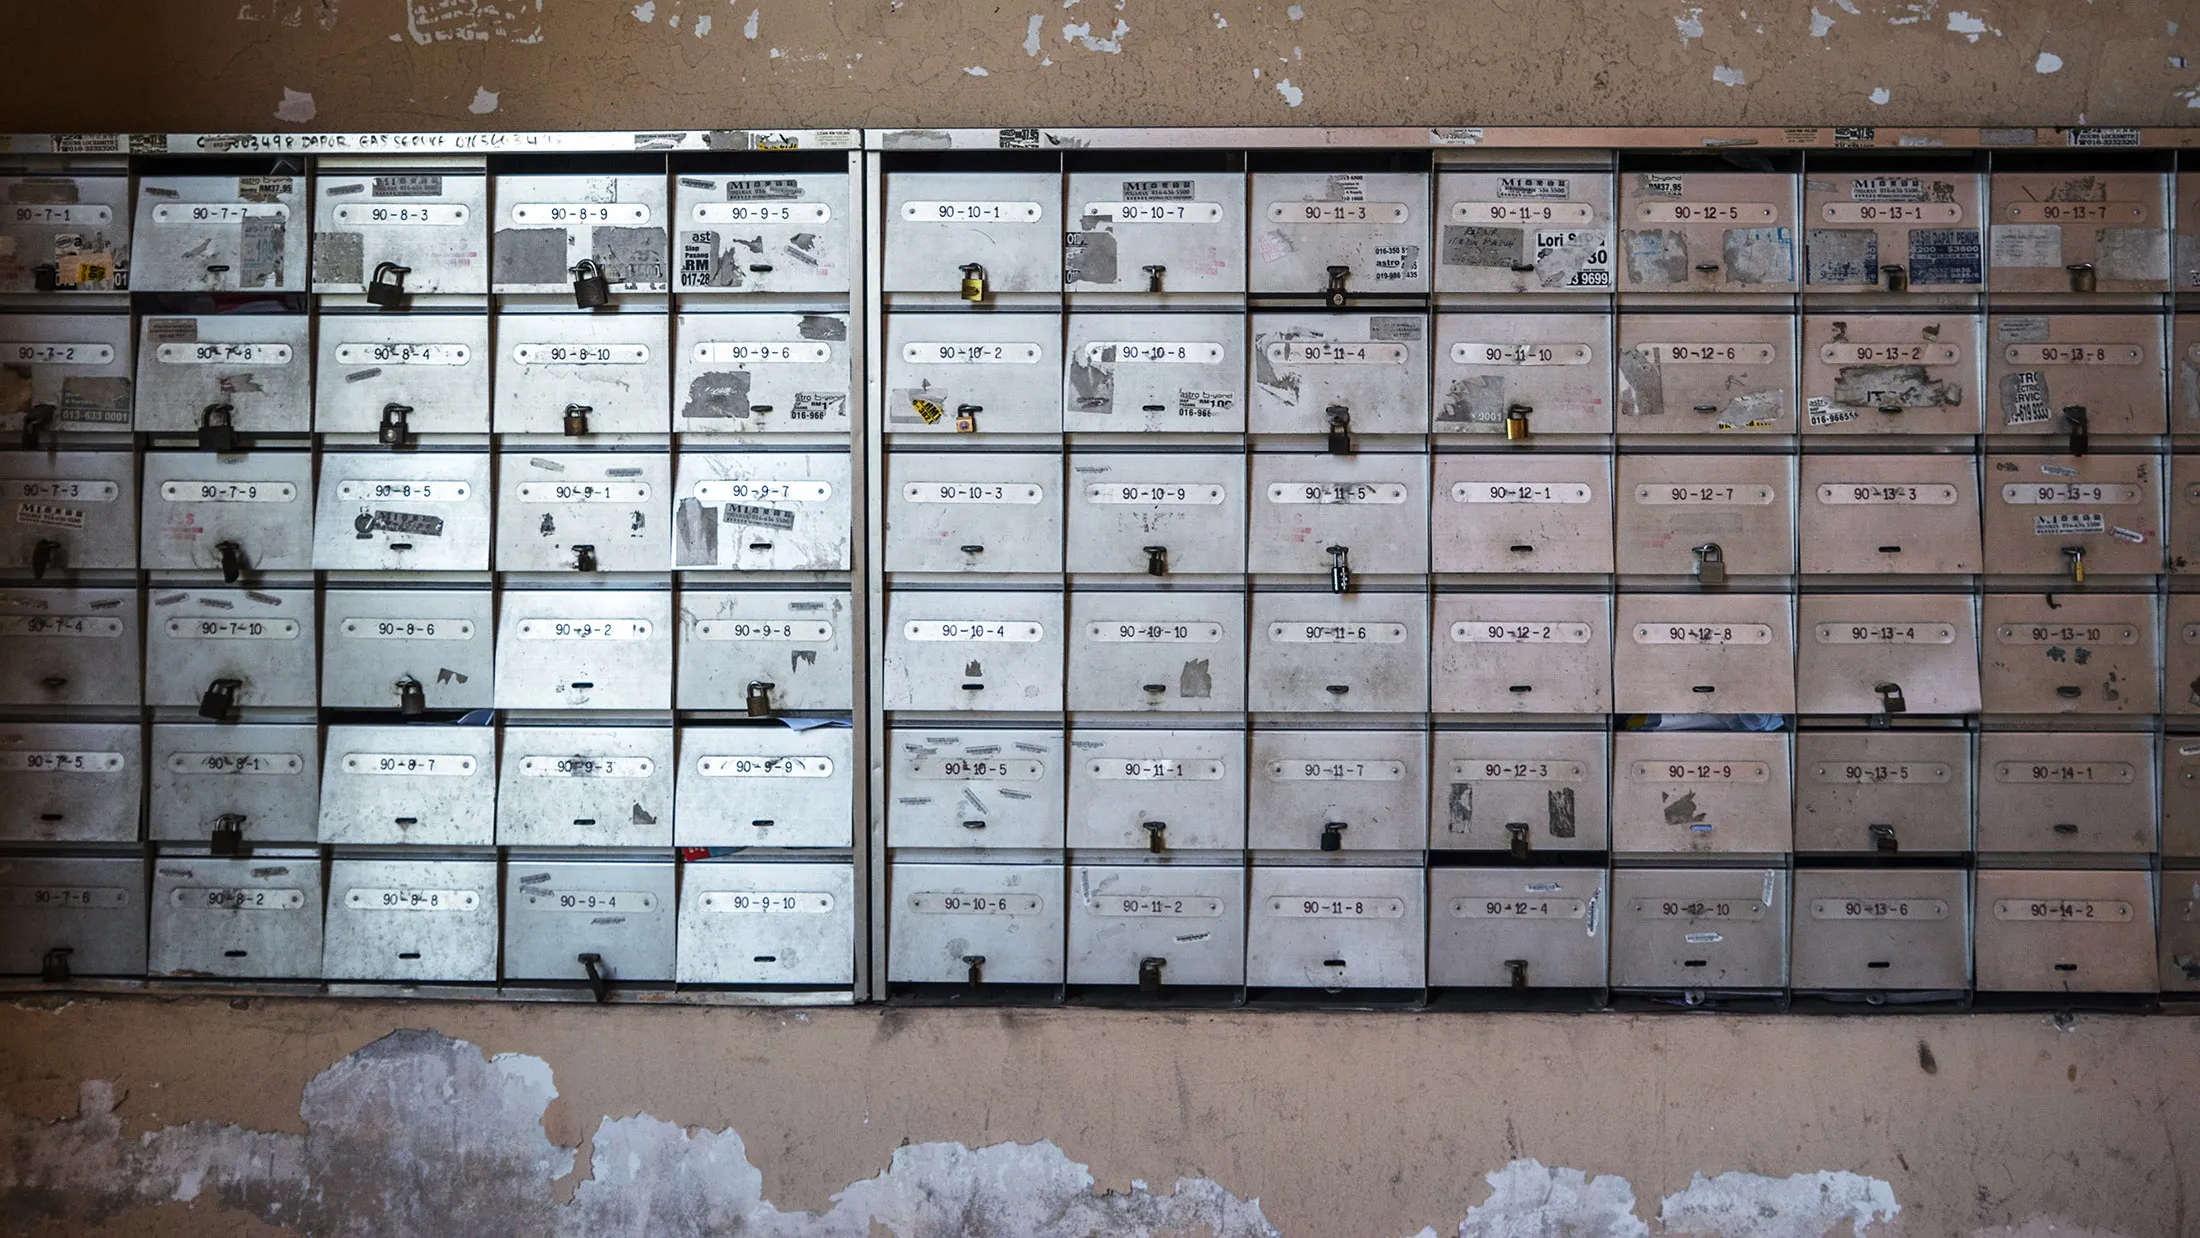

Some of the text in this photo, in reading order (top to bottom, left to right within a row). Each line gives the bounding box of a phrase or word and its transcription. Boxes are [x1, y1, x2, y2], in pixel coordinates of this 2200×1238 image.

[692, 232, 711, 242] ast
[1538, 233, 1564, 247] Lori
[1581, 272, 1608, 284] 9699
[104, 410, 128, 422] 0001
